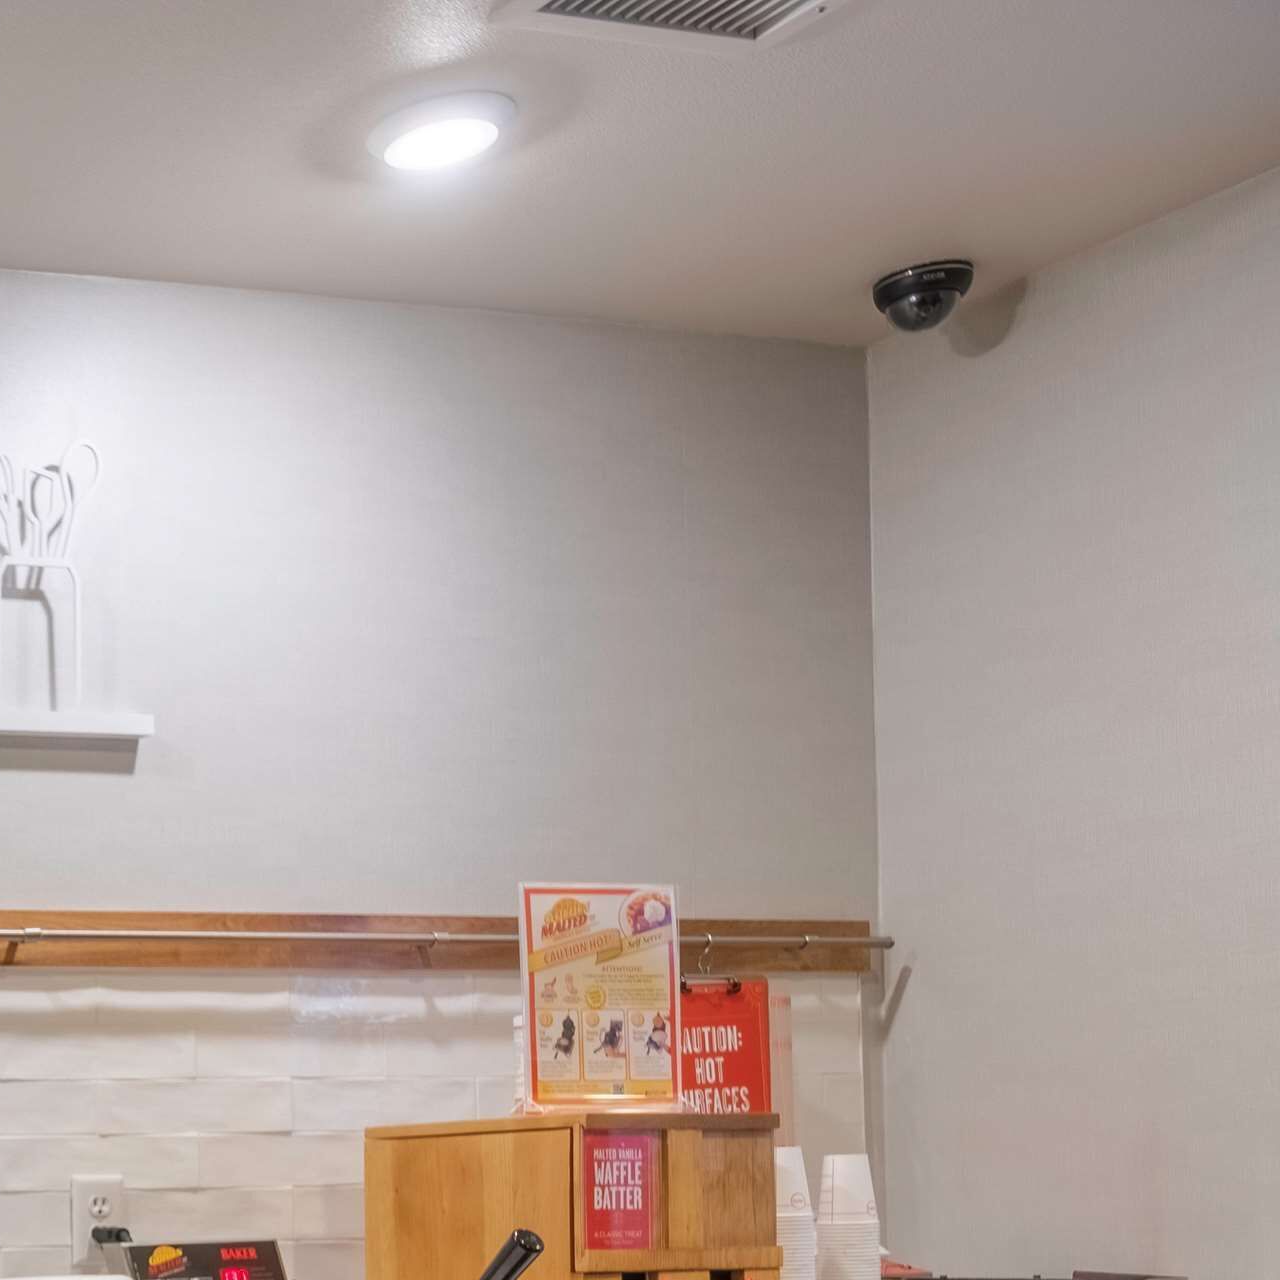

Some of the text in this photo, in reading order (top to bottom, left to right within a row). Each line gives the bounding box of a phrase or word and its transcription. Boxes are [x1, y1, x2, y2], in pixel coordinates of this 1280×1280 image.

[543, 940, 588, 965] CAUTION
[682, 1025, 743, 1055] AUTION:
[694, 1056, 725, 1085] HOT
[682, 1086, 751, 1114] URFACES
[593, 1147, 642, 1160] MALTED VANILLA
[594, 1161, 643, 1185] WAFFLE
[594, 1186, 643, 1211] BATTER
[220, 1247, 258, 1260] BAKER
